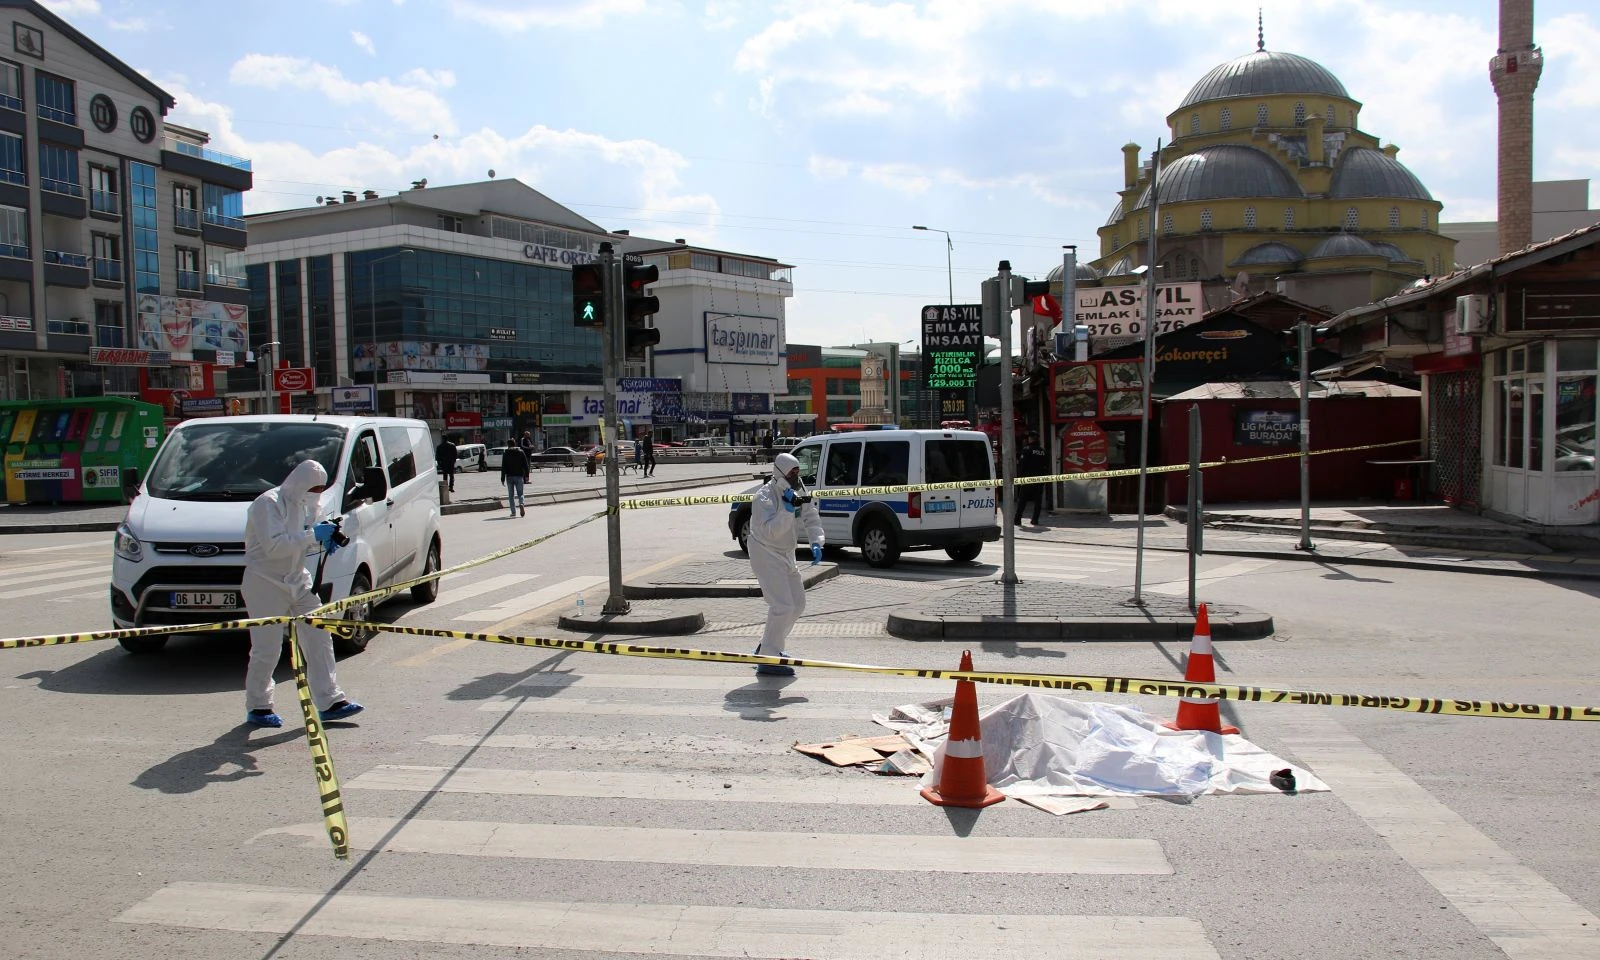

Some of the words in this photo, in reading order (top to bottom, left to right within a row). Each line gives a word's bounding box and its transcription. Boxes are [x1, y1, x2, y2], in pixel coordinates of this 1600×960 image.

[524, 245, 558, 264] CAFE
[942, 307, 980, 320] AS-YIL
[1075, 310, 1130, 320] EMLAK
[1136, 307, 1196, 318] İŞAAT
[925, 322, 980, 333] EMLAK
[925, 334, 980, 346] İNŞAAT
[933, 364, 961, 373] 1000
[14, 471, 41, 479] GETİRME
[99, 469, 118, 477] SIFIR
[967, 496, 995, 509] POLİS
[195, 546, 212, 554] Ford
[176, 593, 188, 605] 06
[193, 593, 213, 605] LPJ
[223, 593, 236, 604] 26
